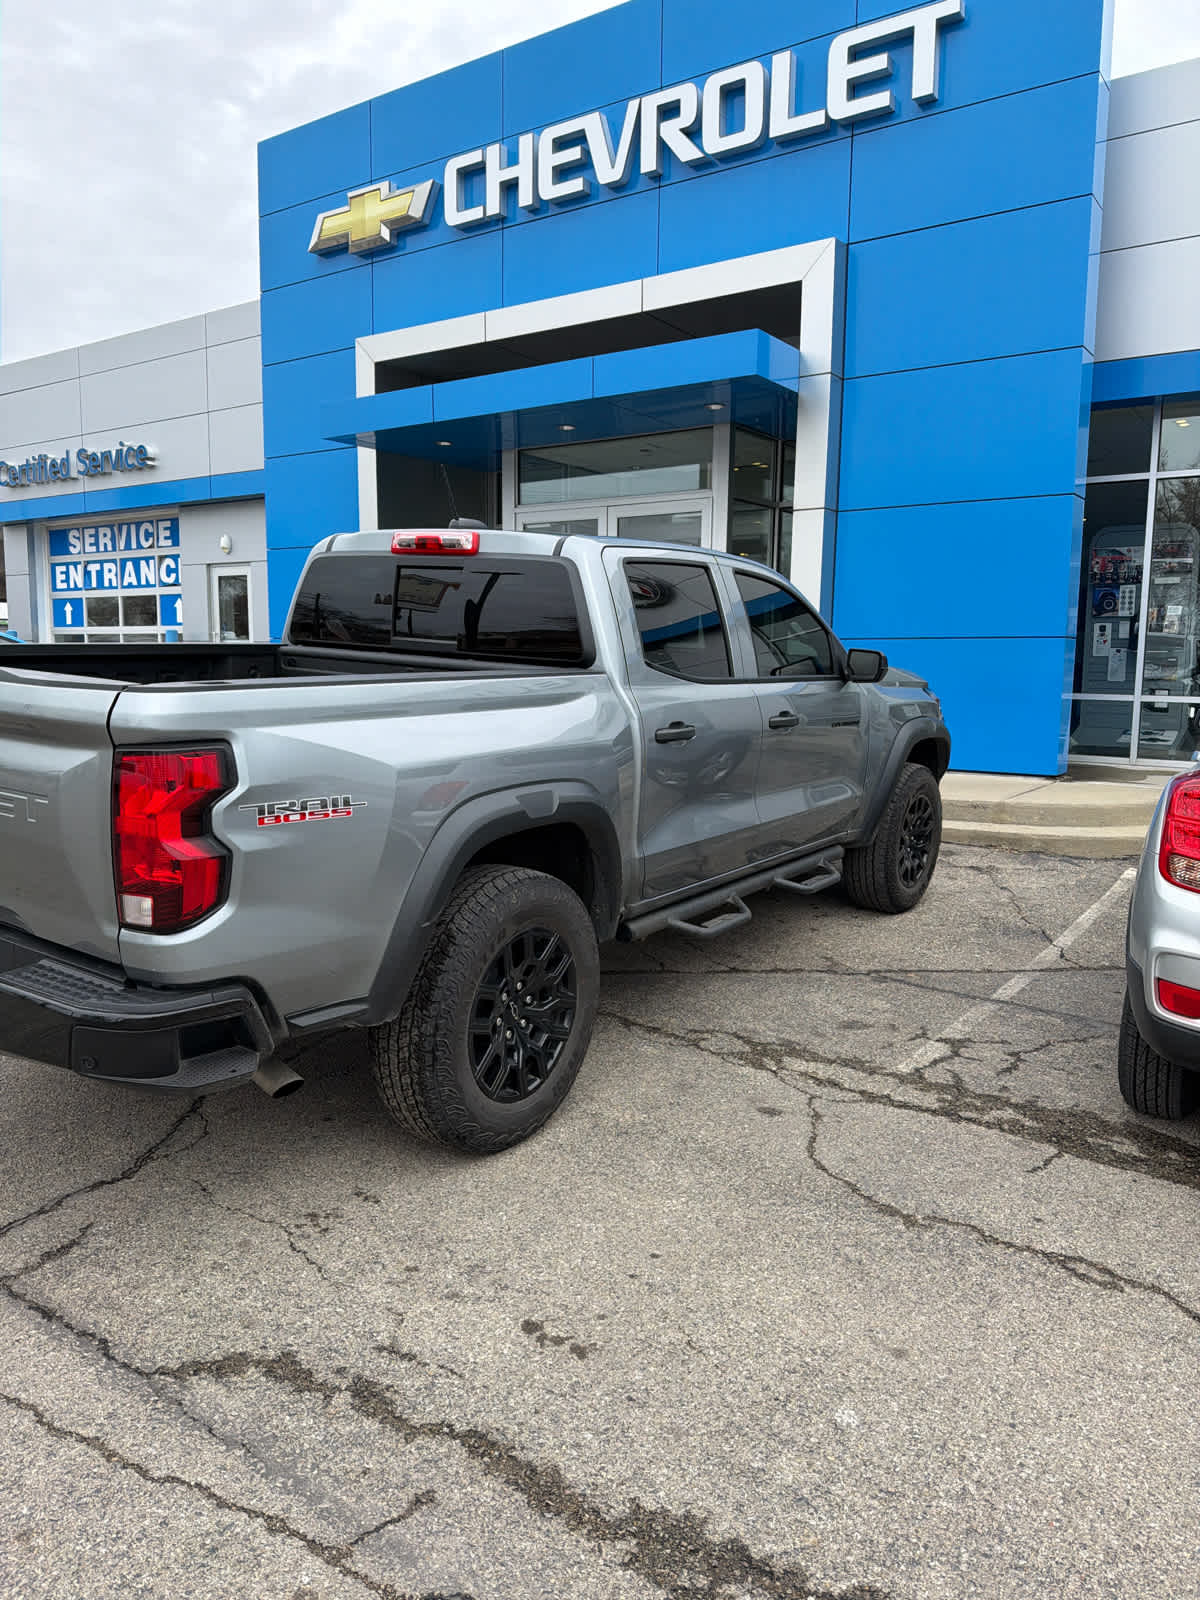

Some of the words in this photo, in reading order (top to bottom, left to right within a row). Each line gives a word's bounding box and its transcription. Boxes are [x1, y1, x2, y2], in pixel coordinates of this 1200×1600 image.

[444, 0, 965, 228] CHEVROLET
[0, 449, 70, 487] Certified
[77, 441, 148, 476] Service
[68, 521, 173, 554] SERVICE
[55, 557, 182, 589] ENTRANC
[239, 795, 367, 816] TRAIL
[257, 806, 352, 827] BOSS
